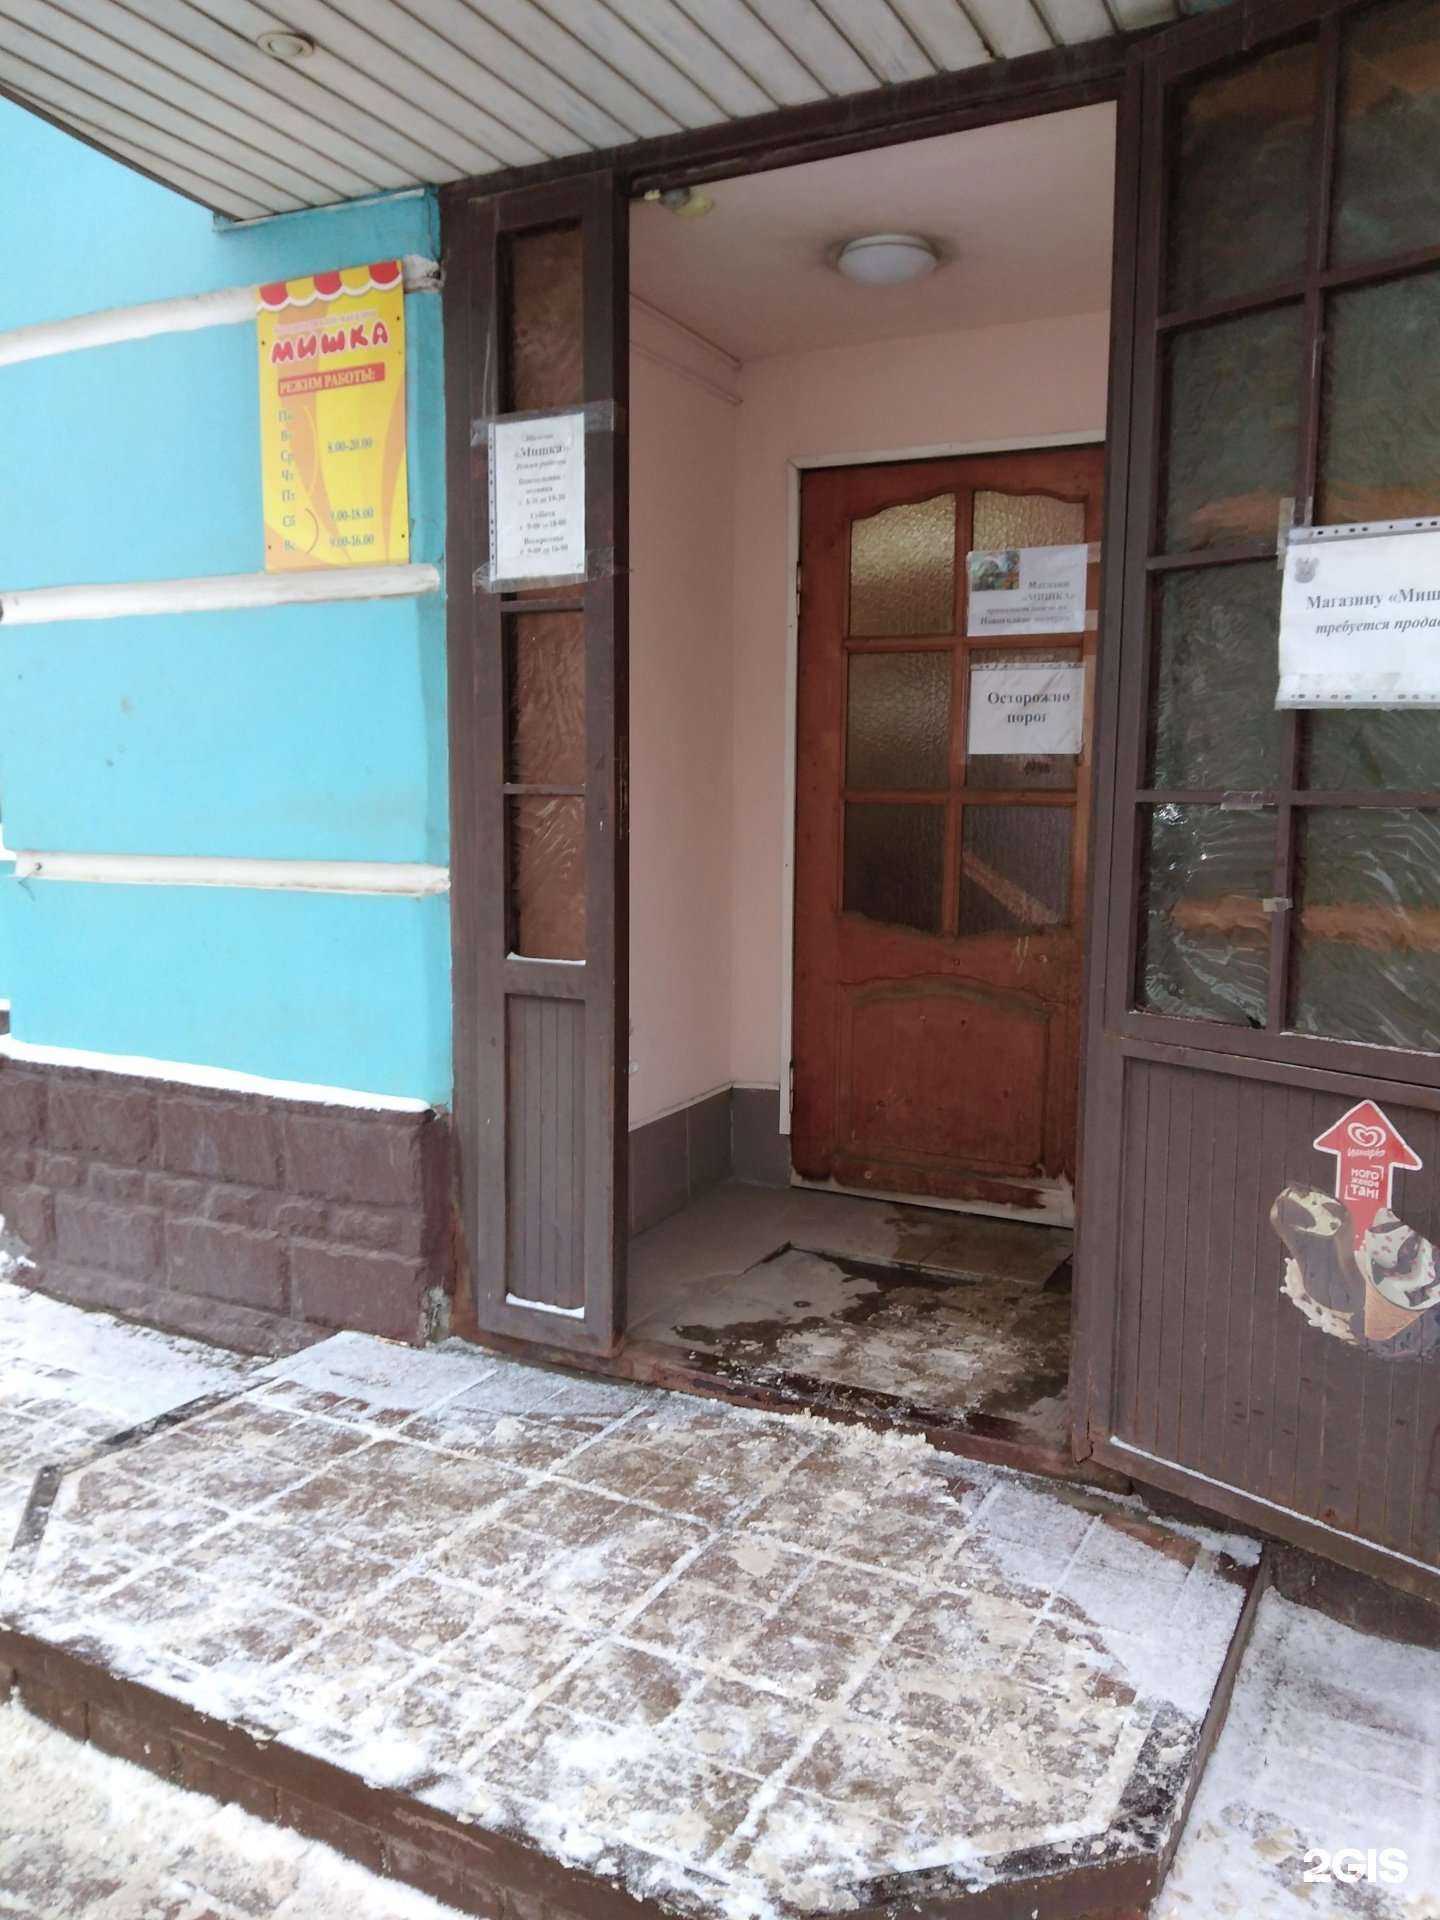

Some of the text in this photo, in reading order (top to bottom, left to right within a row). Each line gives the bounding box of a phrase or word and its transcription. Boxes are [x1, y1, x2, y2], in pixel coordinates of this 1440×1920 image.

[272, 321, 388, 364] МИШКА
[279, 367, 377, 394] РЕЖИМ РАБОТЫ:
[1306, 594, 1383, 609] Магазину
[1315, 618, 1390, 636] требуется
[987, 691, 1071, 707] Осторожно
[1007, 712, 1047, 727] порог
